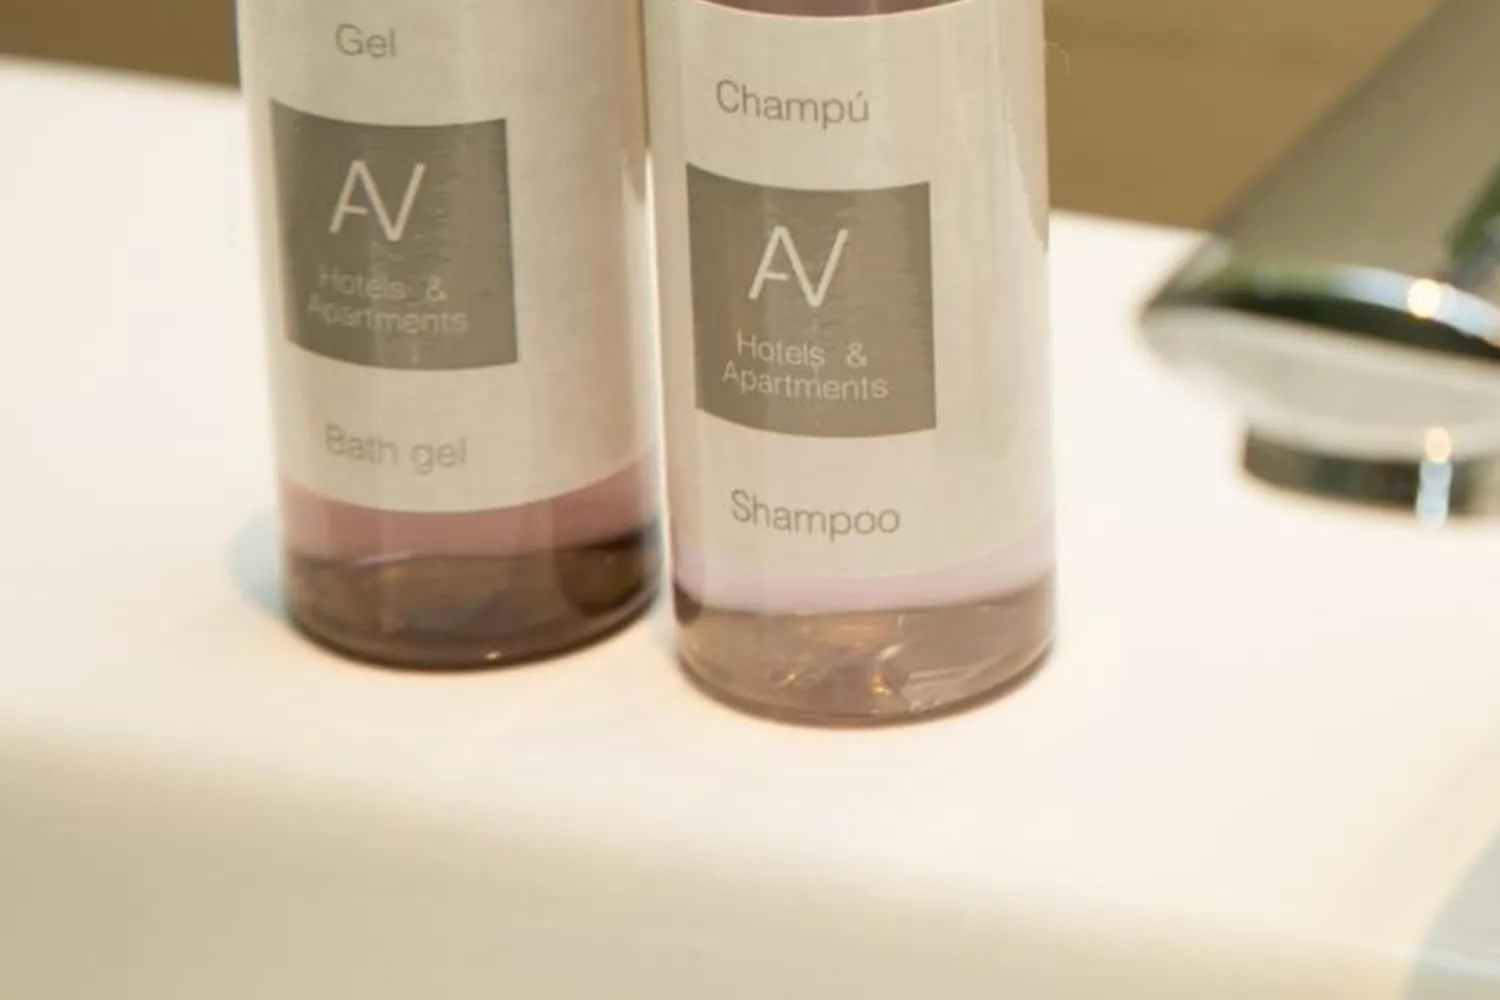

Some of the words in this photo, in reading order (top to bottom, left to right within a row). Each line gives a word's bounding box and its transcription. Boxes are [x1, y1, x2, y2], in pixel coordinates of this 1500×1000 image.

[334, 23, 398, 60] Gel
[714, 78, 871, 131] Champú
[328, 159, 427, 243] AV
[317, 263, 406, 301] Hotels
[424, 274, 448, 302] &
[748, 224, 849, 308] AV
[306, 292, 469, 335] Apartments
[736, 328, 826, 367] Hotels
[846, 341, 868, 367] &
[722, 359, 889, 401] Apartments
[324, 422, 399, 466] Bath
[409, 436, 468, 475] gel
[730, 488, 901, 542] Shampoo
